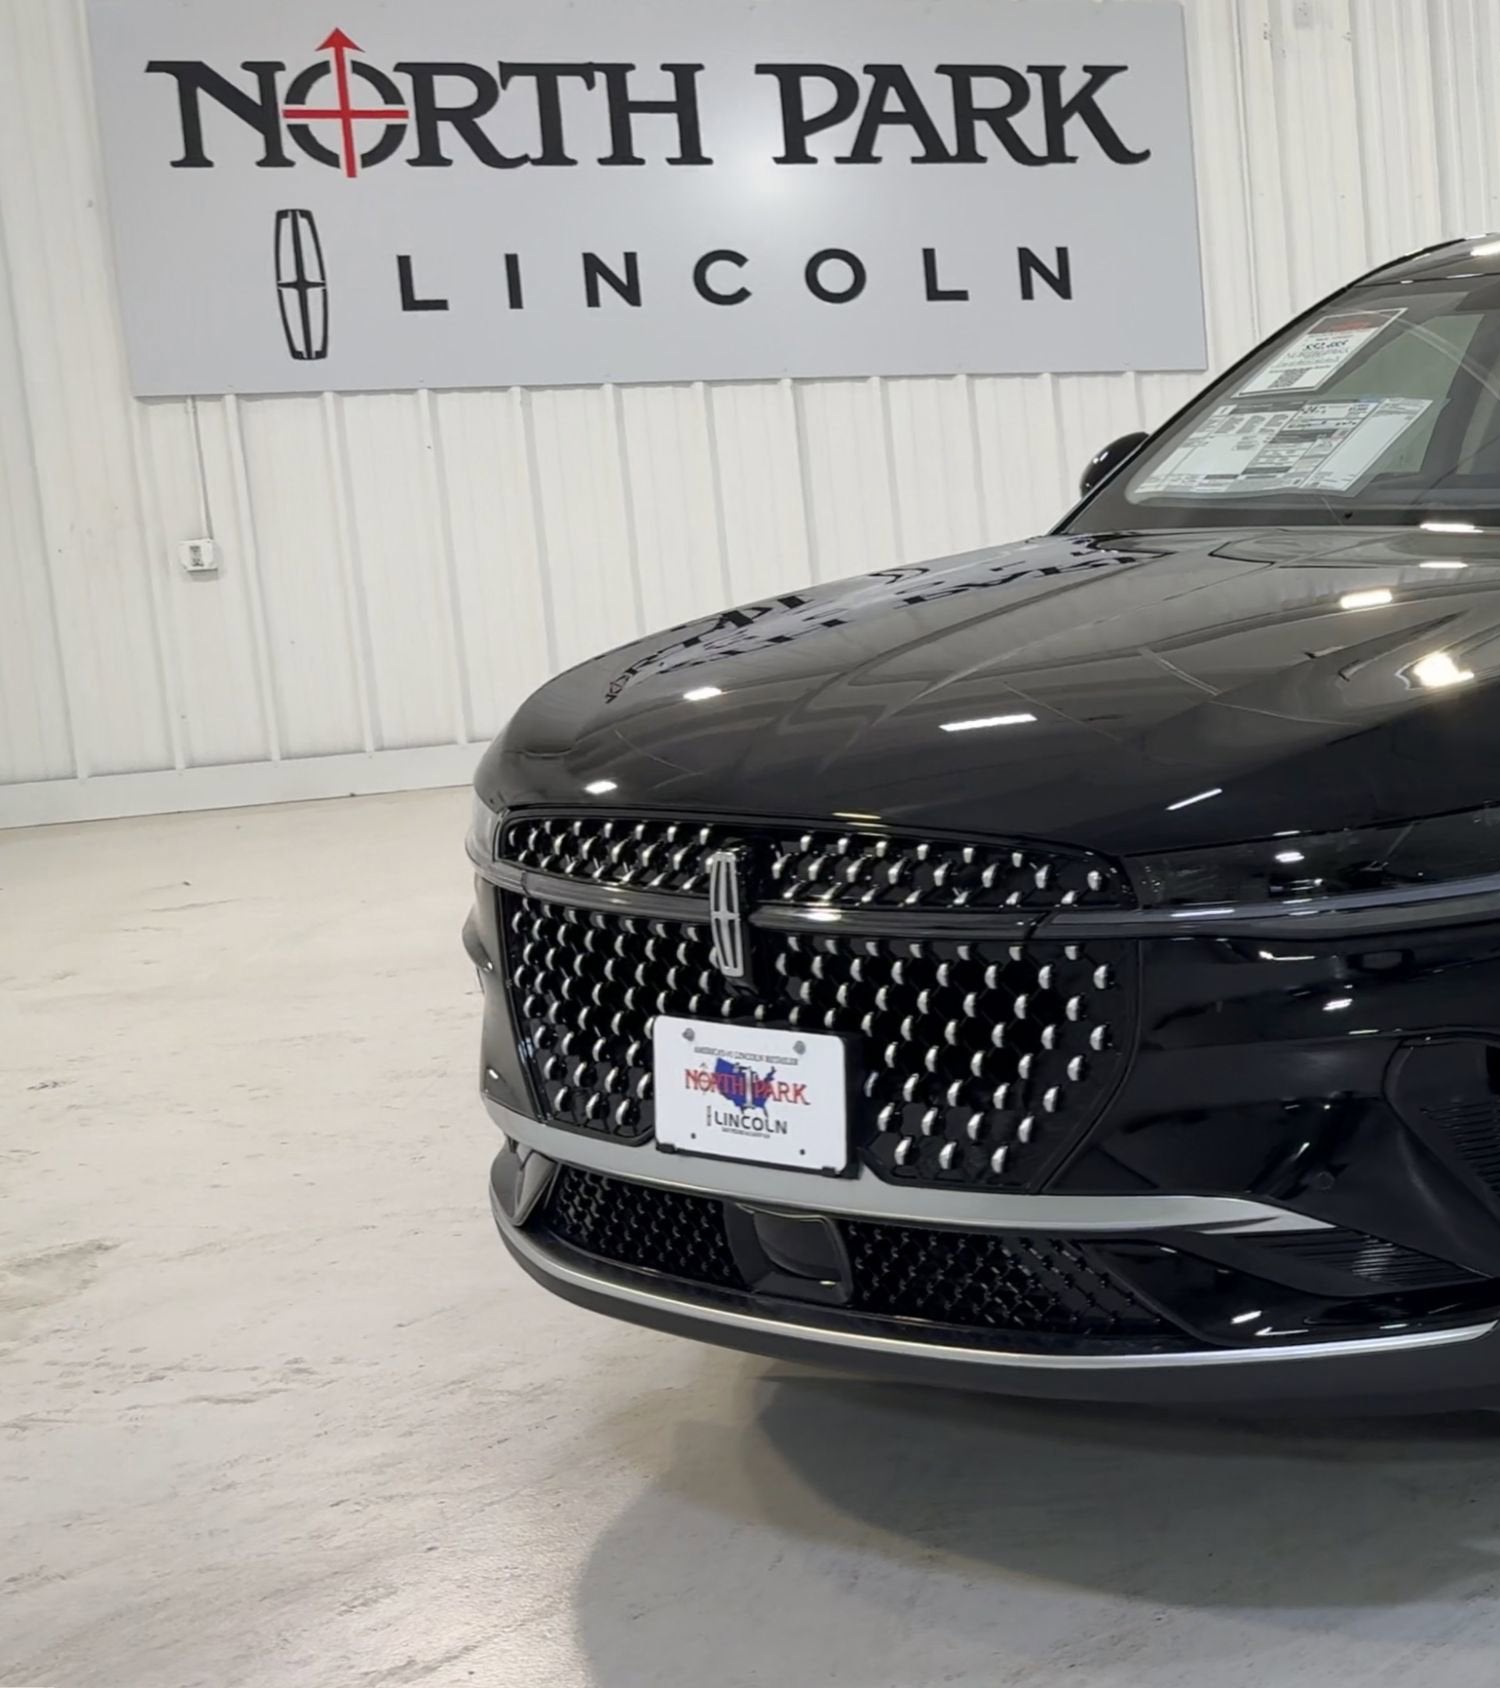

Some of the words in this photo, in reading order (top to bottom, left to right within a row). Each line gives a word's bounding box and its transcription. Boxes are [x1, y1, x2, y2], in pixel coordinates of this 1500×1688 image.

[145, 58, 713, 176] NORTH
[754, 62, 1152, 166] PARK
[397, 245, 1075, 311] LINCOLN
[685, 1068, 746, 1096] NORTH
[755, 1078, 811, 1105] PARK
[714, 1110, 788, 1134] LINCOLN
